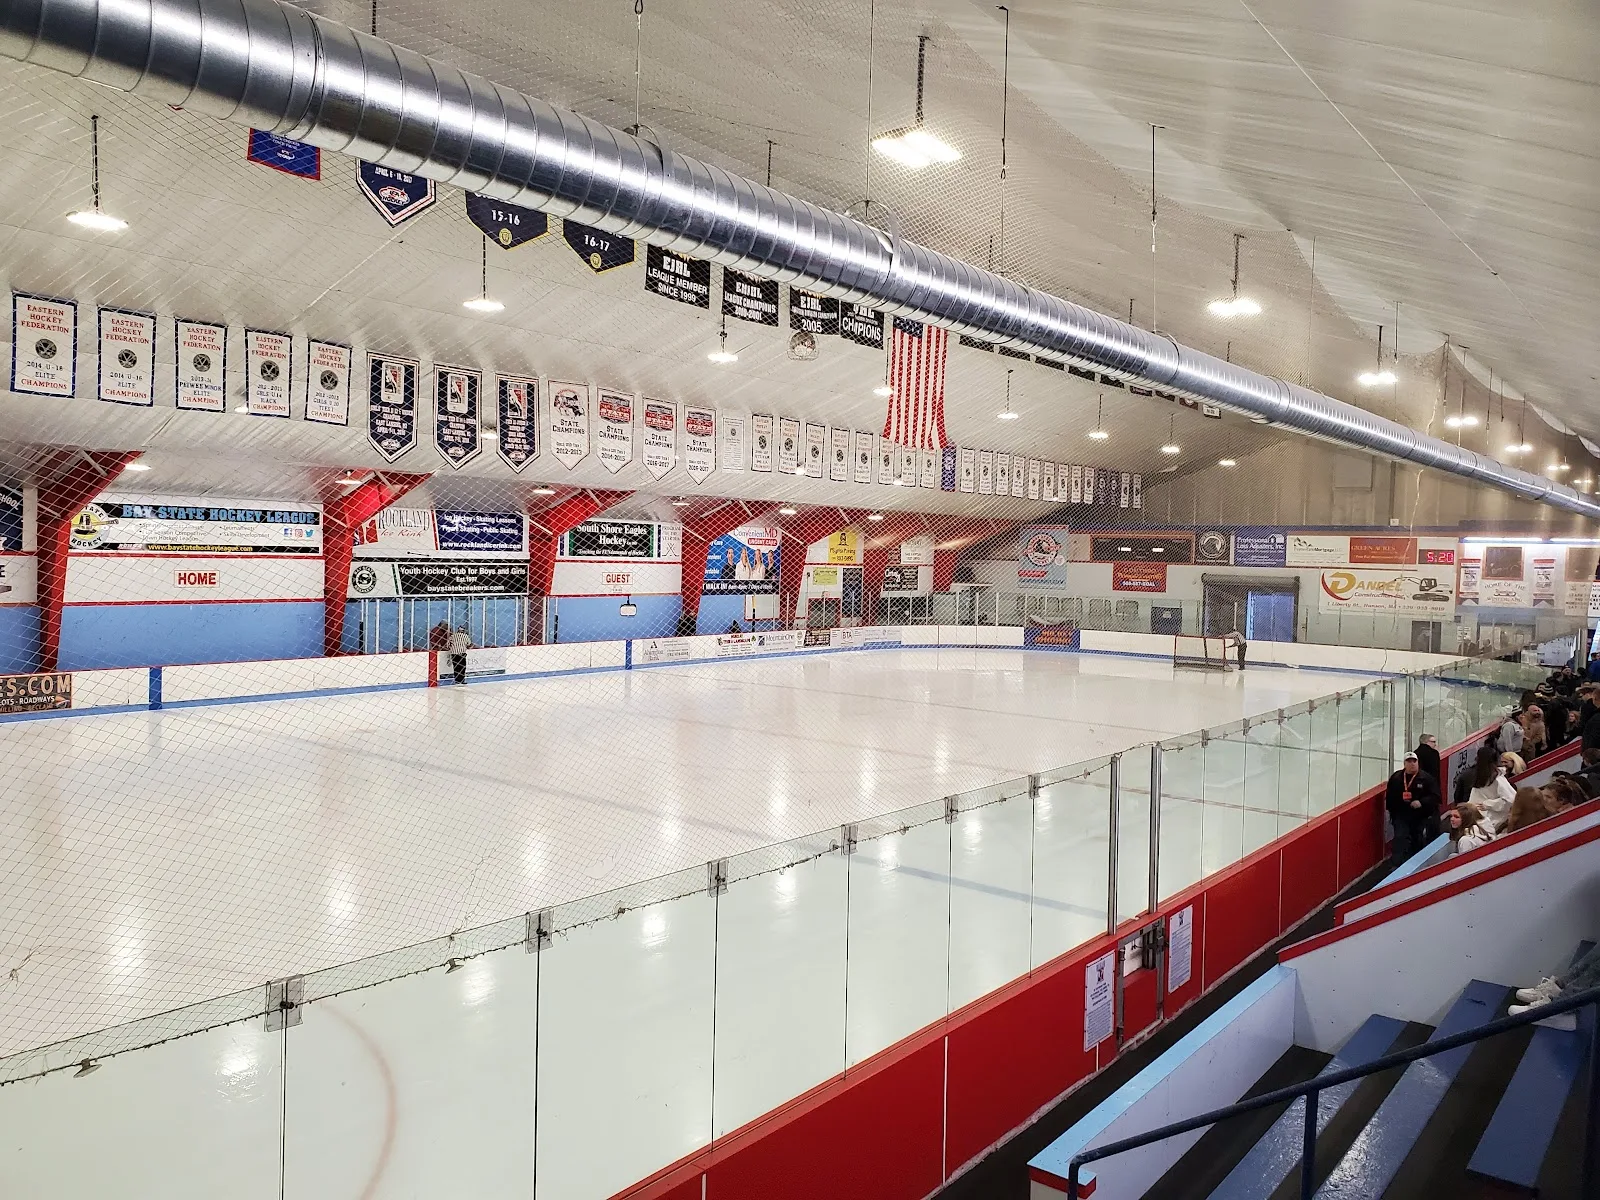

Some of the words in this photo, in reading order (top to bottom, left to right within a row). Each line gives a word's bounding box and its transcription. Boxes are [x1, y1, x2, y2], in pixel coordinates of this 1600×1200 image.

[375, 167, 389, 177] APRIL
[382, 196, 404, 206] HOCKEY
[491, 210, 520, 226] 15-16
[584, 234, 610, 252] 16-17
[663, 256, 690, 278] EJHL
[648, 267, 674, 284] LEAGUE
[676, 277, 708, 295] MEMBER
[658, 282, 678, 298] SINCE
[680, 290, 696, 302] 1999
[724, 291, 742, 306] LEAGUE
[743, 298, 776, 314] CHAMPIONS
[800, 296, 822, 311] EJHL
[27, 304, 64, 316] EASTERN
[30, 314, 63, 324] HOCKEY
[111, 318, 144, 329] EASTERN
[21, 320, 70, 334] FEDERATION
[801, 318, 822, 332] 2005
[112, 326, 142, 336] HOCKEY
[187, 327, 216, 335] EASTERN
[105, 334, 150, 344] FEDERATION
[190, 334, 215, 342] HOCKEY
[256, 336, 284, 344] EASTERN
[318, 346, 343, 356] EASTERN
[314, 359, 346, 370] FEDERATION
[35, 372, 56, 380] ELITE
[21, 378, 67, 390] CHAMPIONS
[105, 388, 148, 399] CHAMPIONS
[182, 396, 218, 405] CHAMPIONS
[252, 403, 286, 412] CHAMPIONS
[310, 410, 343, 420] CHAMPIONS
[560, 418, 579, 427] STATE
[552, 425, 585, 434] CHAMPIONS
[607, 426, 624, 434] STATE
[599, 430, 630, 442] CHAMPIONS
[652, 434, 668, 442] STATE
[644, 438, 672, 448] CHAMPIONS
[686, 445, 712, 454] CHAMPIONS
[122, 505, 154, 518] BAY
[158, 506, 205, 521] STATE
[210, 508, 262, 522] HOCKEY
[266, 510, 316, 524] LEAGUE
[378, 509, 430, 530] ROCKLAND
[398, 530, 422, 538] Rink
[460, 526, 480, 534] Skating
[577, 524, 599, 533] South
[600, 524, 622, 534] Shore
[624, 525, 647, 536] Eagles
[734, 527, 778, 538] ConvenientMD
[72, 537, 102, 548] HOCKEY
[442, 542, 522, 550] www.rocklandicerink.com
[600, 535, 627, 547] Hockey
[148, 544, 253, 552] www.baystatehockeyleague.com
[1427, 551, 1454, 562] 5:20
[422, 567, 448, 576] Hockey
[480, 568, 496, 576] Boys
[178, 572, 216, 586] HOME
[606, 574, 630, 583] GUEST
[428, 585, 505, 593] baystatebreakers.com
[20, 696, 54, 704] ROADWAYS
